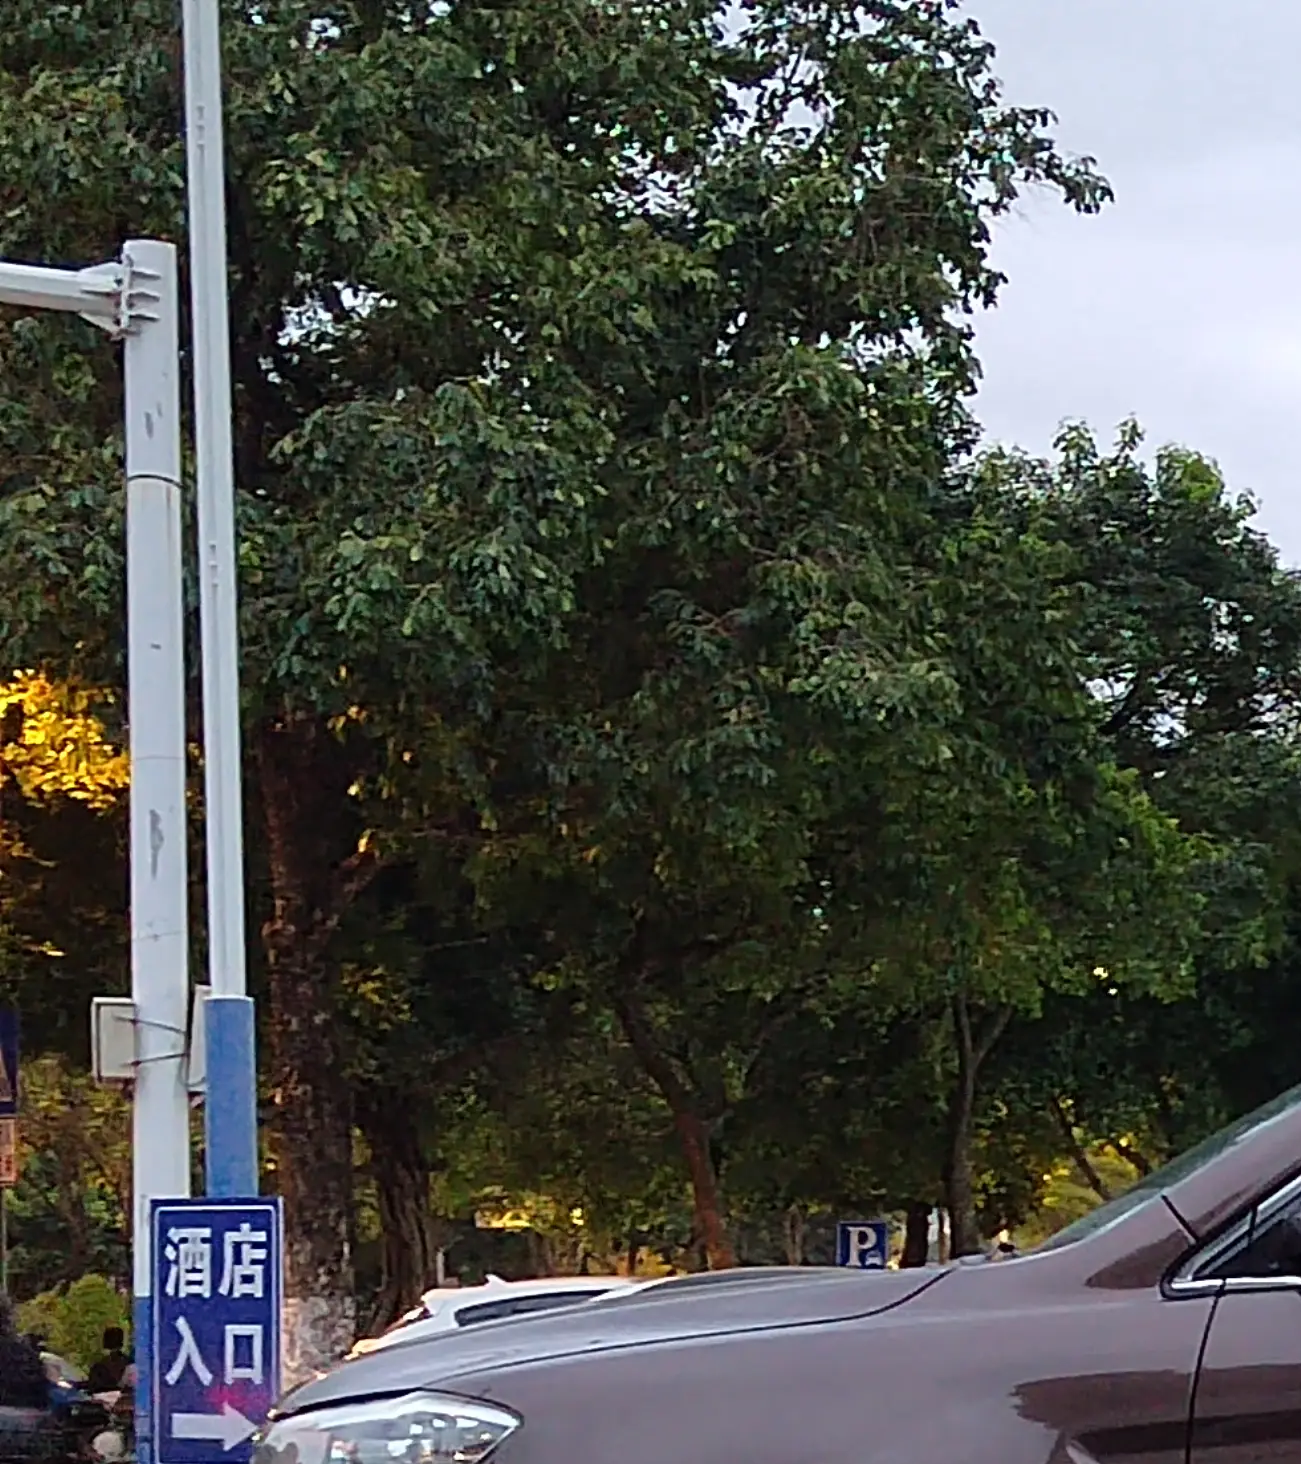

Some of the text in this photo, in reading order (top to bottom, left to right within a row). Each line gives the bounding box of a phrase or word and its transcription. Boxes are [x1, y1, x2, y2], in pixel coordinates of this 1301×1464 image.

[164, 1223, 267, 1298] 酒店
[845, 1226, 877, 1267] P
[165, 1317, 263, 1386] 入口
